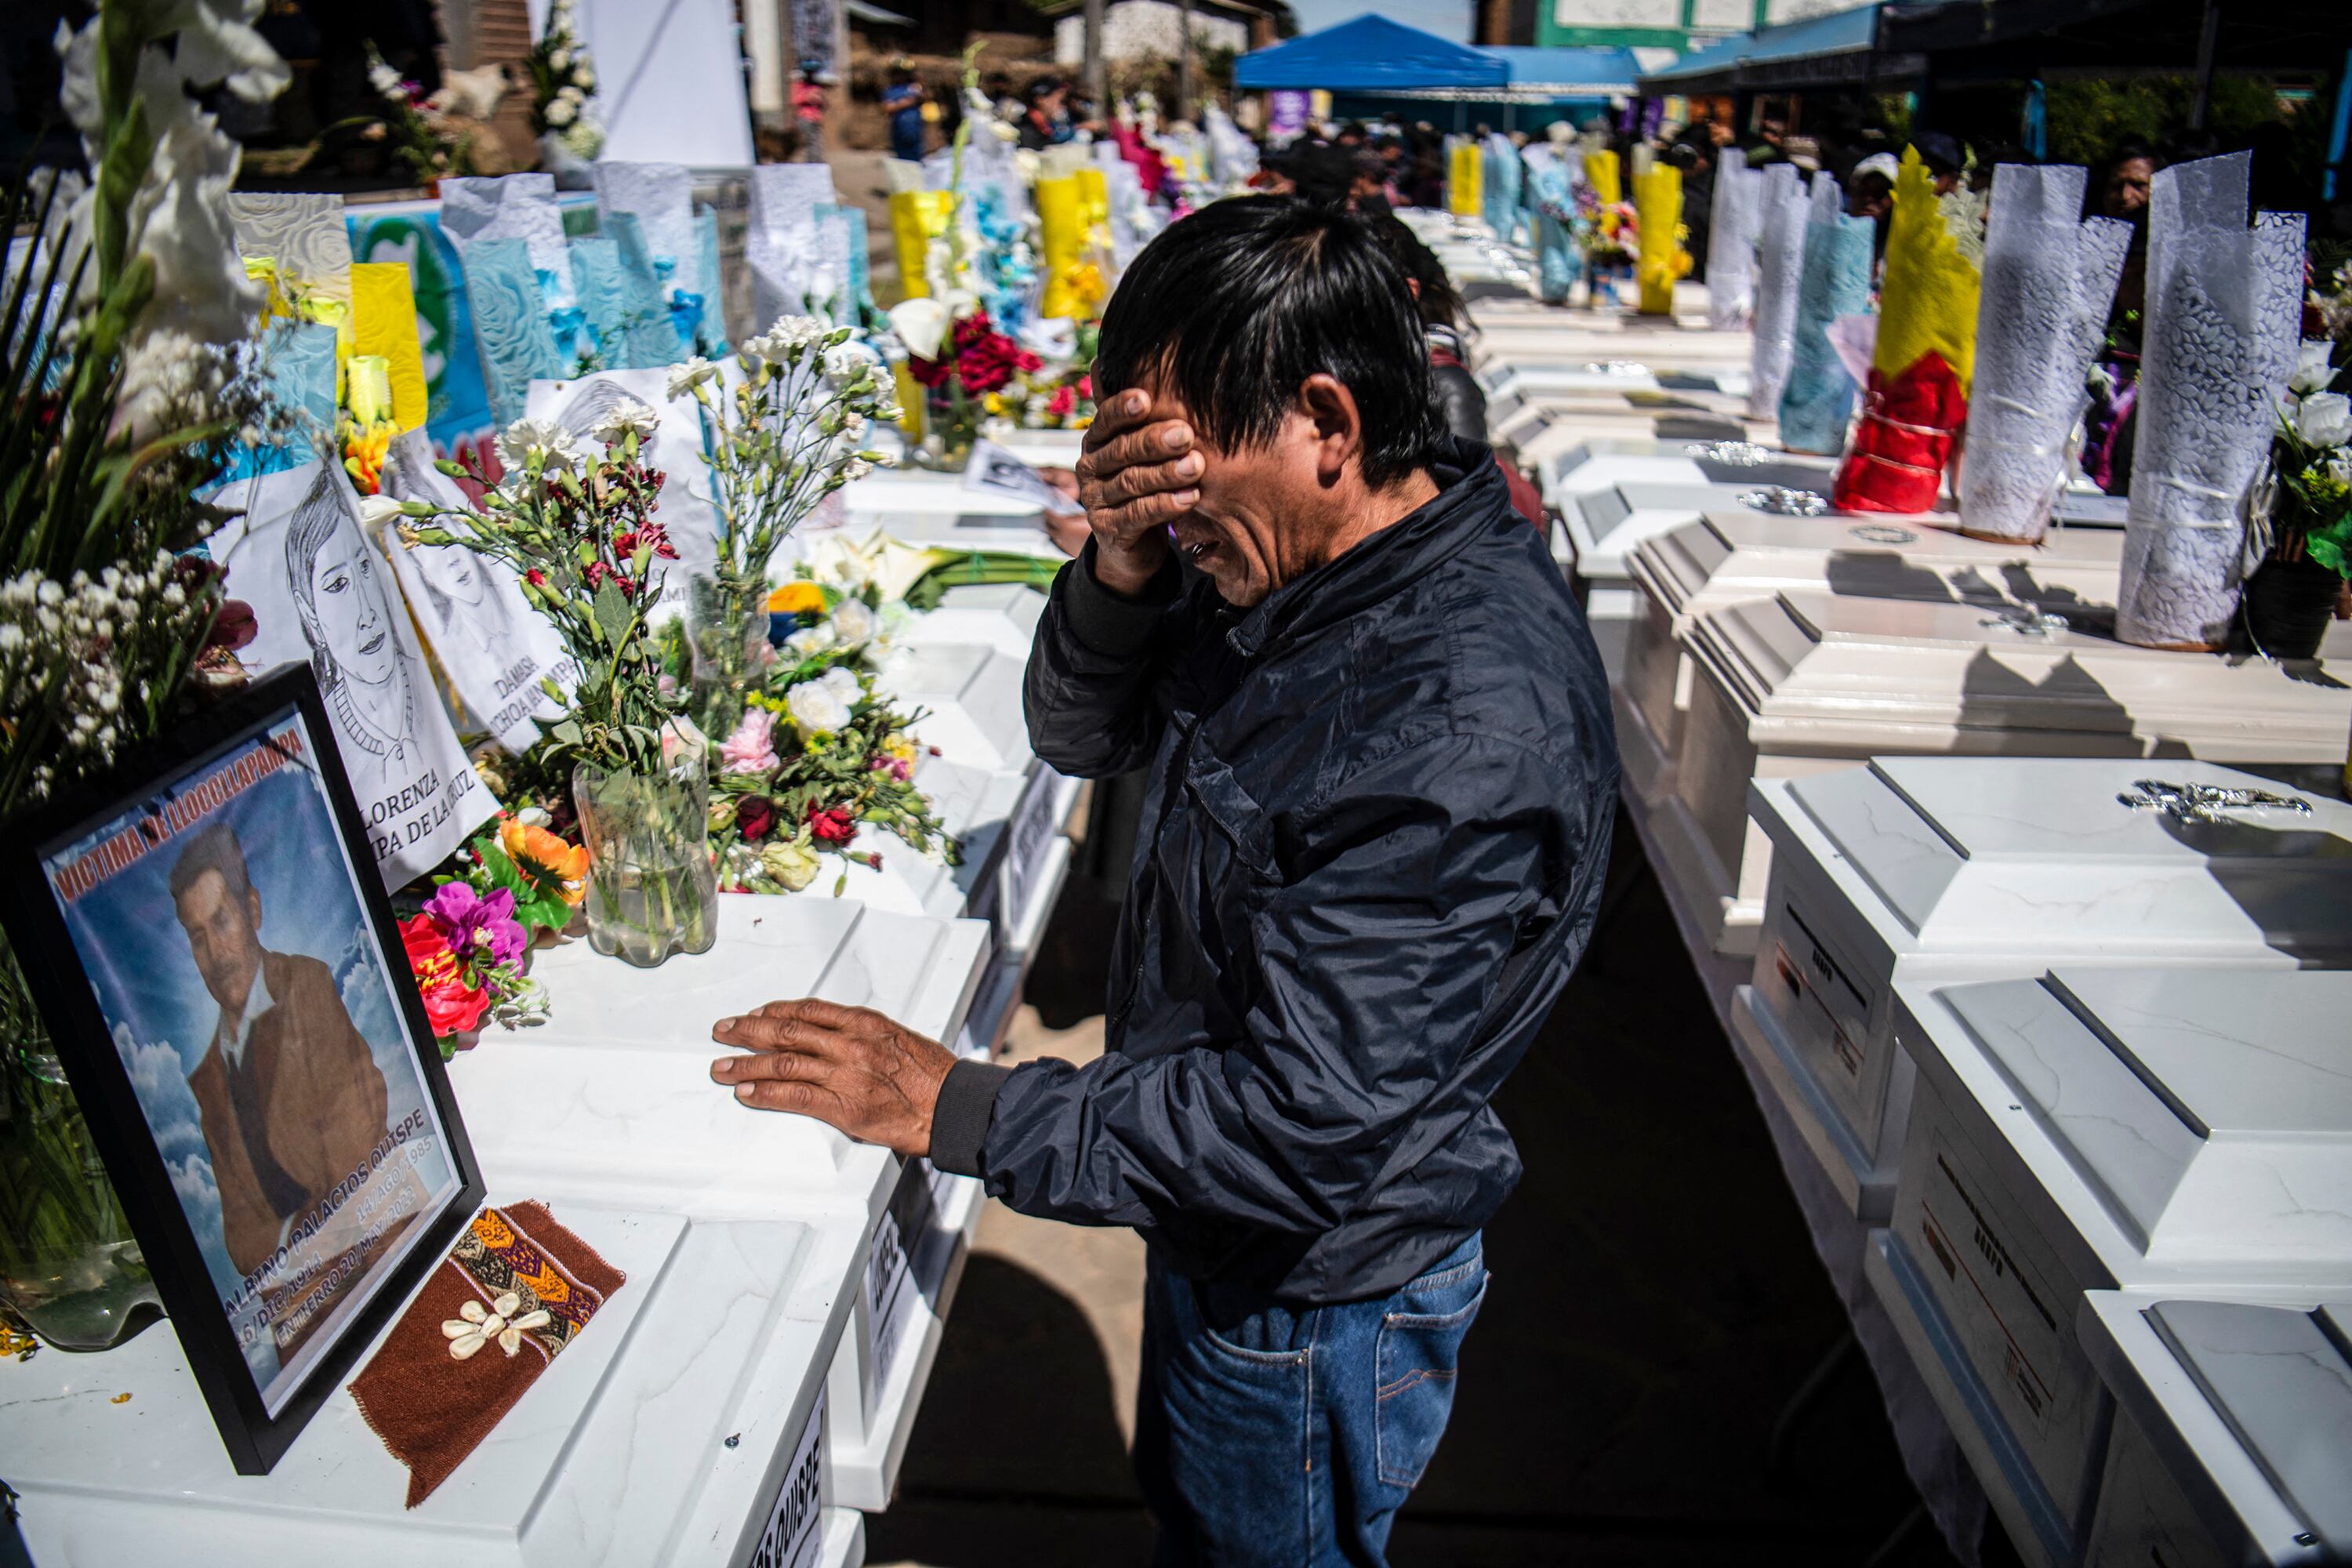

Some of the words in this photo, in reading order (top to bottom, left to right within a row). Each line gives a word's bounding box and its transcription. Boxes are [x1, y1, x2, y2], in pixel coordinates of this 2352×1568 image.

[359, 768, 441, 830] LORENZA
[407, 812, 434, 844] DE
[433, 798, 451, 827] LA
[54, 824, 146, 902] VICTIMA
[140, 810, 172, 851] DE
[226, 1244, 289, 1316] ALBINO
[290, 1161, 370, 1255] PALACIOS
[370, 1109, 425, 1172] QUISPE
[356, 1137, 432, 1225] 14/AGO/1985
[275, 1268, 340, 1348] ENTIERRO
[339, 1185, 416, 1278] 20/MAY/2022
[775, 1435, 820, 1568] QUISPE
